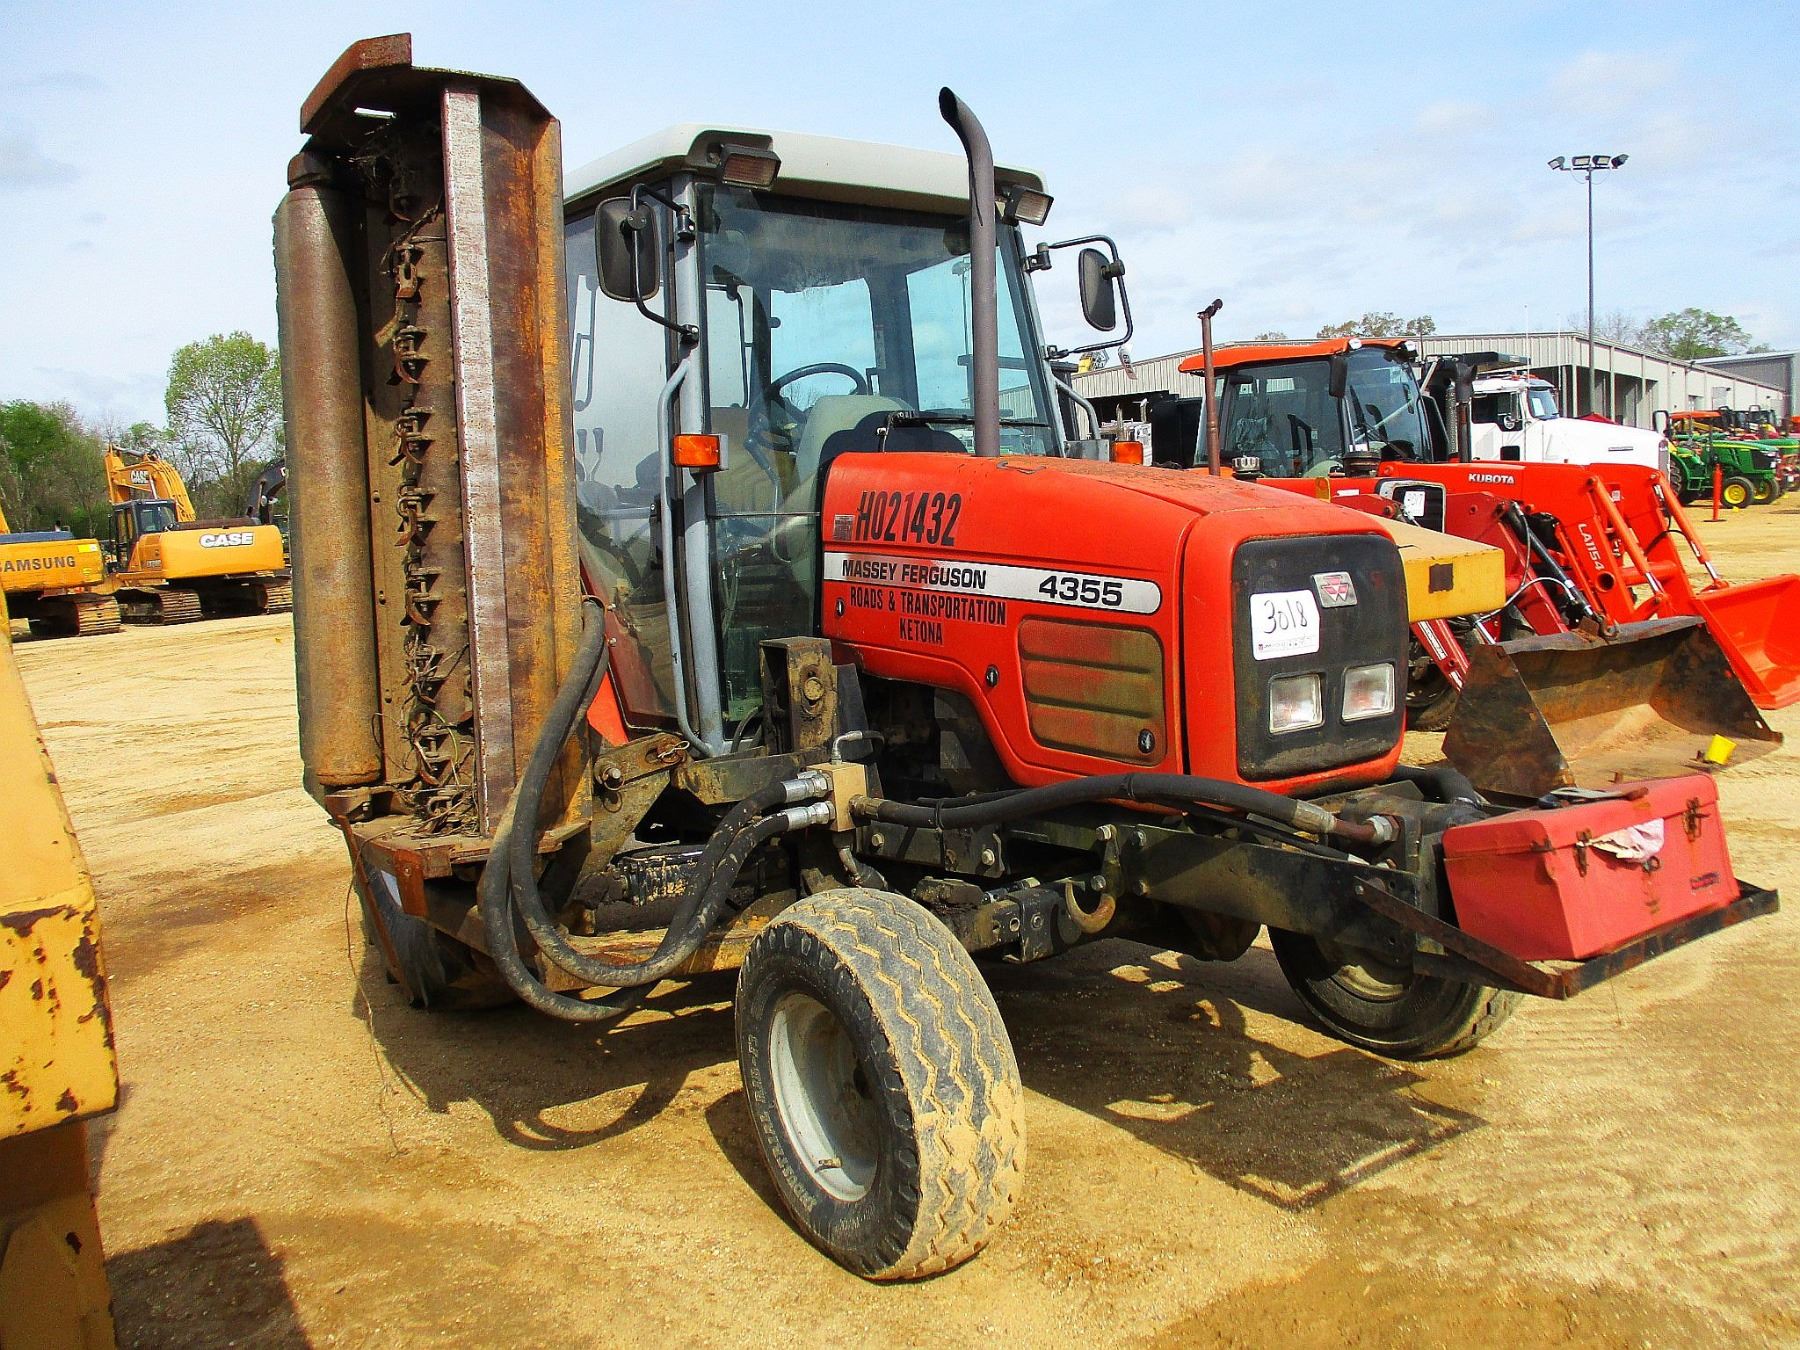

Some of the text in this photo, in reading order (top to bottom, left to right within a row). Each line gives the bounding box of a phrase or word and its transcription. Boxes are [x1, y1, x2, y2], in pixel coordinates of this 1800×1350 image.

[131, 470, 149, 484] CASE
[1468, 473, 1515, 485] KUBOTA
[199, 532, 254, 548] CASE
[1578, 523, 1605, 571] LA1154
[842, 559, 1123, 607] MASSEY FERGUSON 4355
[850, 586, 1006, 626] ROADS & TRANSPORTATION
[1263, 599, 1308, 634] 3018
[900, 618, 943, 645] KETONA
